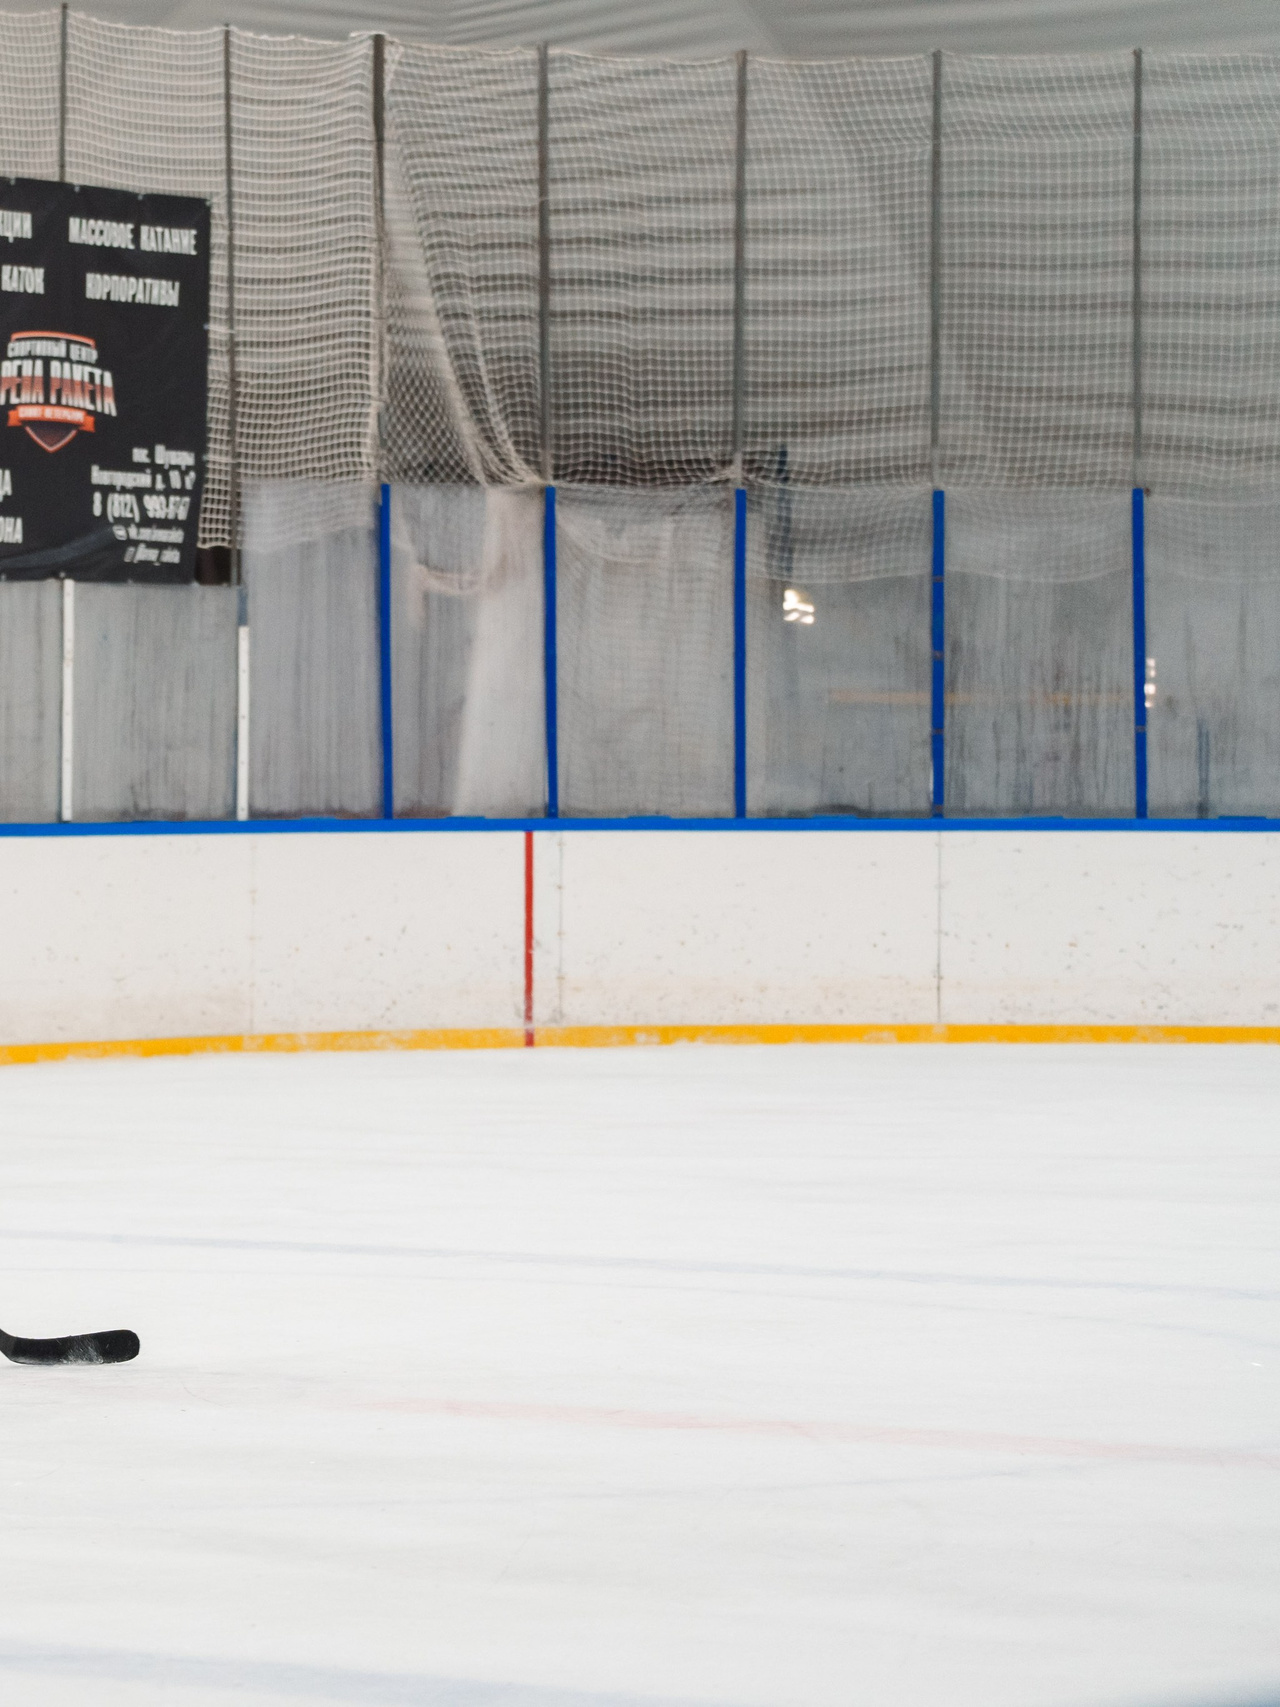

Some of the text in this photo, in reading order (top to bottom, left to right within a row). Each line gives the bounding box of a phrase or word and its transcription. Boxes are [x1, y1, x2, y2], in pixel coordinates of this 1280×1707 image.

[69, 216, 197, 256] МАССОВОЕ КАТАНИЕ
[1, 264, 45, 294] КАТОК
[85, 272, 180, 307] КОРПОРАТИВЫ
[49, 360, 117, 417] РАКЕТА
